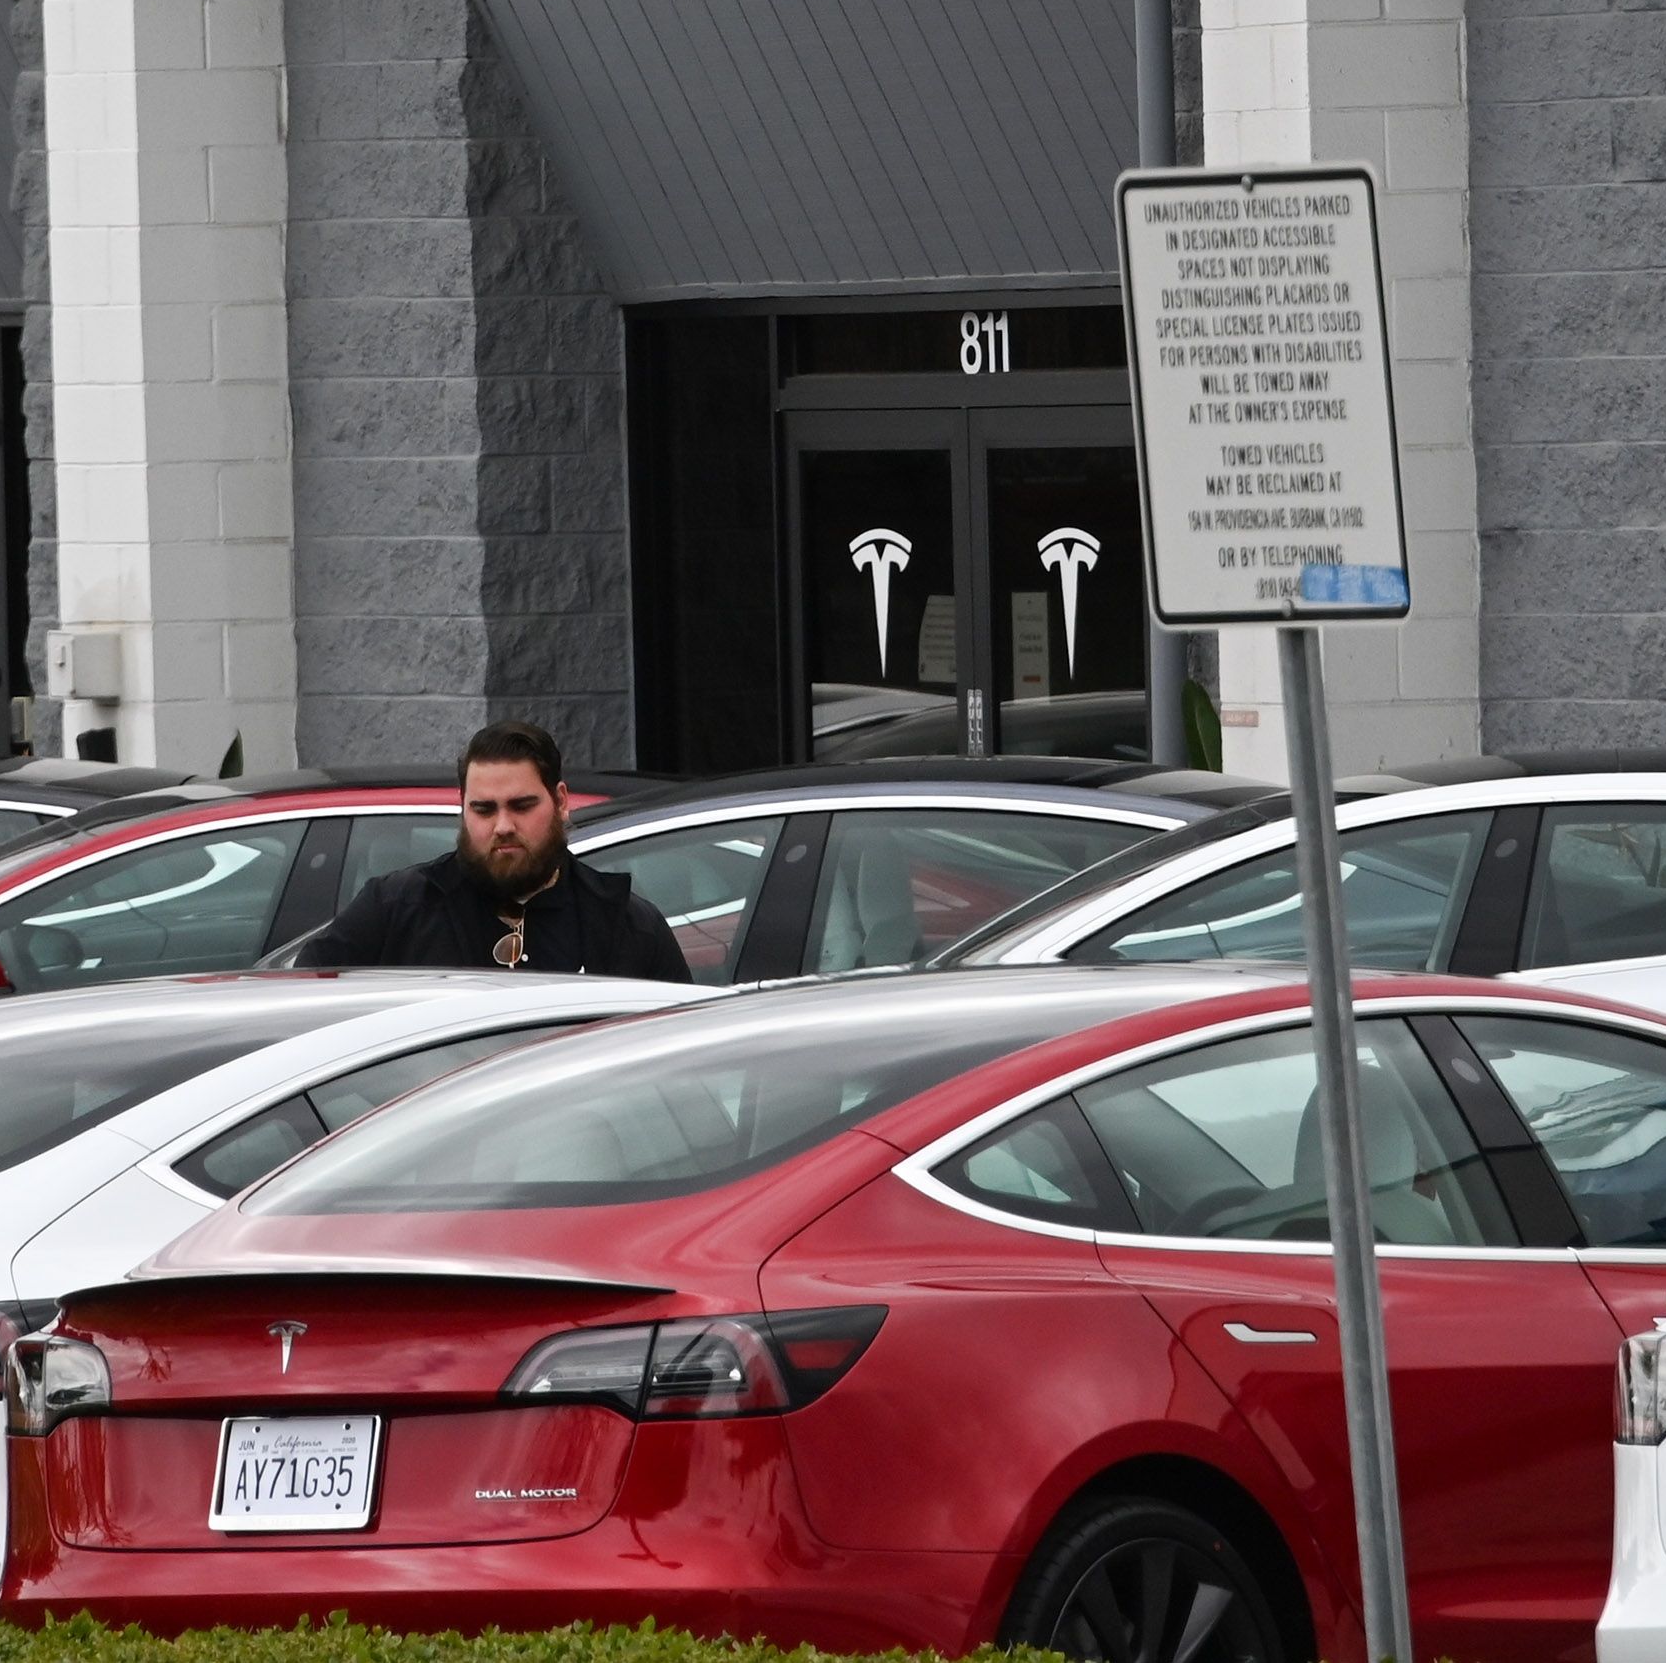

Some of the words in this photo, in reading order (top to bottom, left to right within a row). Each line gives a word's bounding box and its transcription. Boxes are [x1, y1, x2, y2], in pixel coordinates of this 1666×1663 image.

[1144, 200, 1239, 224] UNAUTHORIZED
[1243, 197, 1300, 220] VEHICLES
[1304, 195, 1350, 216] PARKED
[1165, 230, 1178, 252] IN
[1183, 228, 1258, 251] DESIGNATED
[1263, 224, 1336, 248] ACCESSIBLE
[1178, 257, 1225, 280] SPACES
[1230, 256, 1253, 278] NOT
[1258, 254, 1330, 277] DISPLAYING
[1161, 286, 1262, 310] DISTINGUISHING
[1266, 283, 1329, 306] PLACARDS
[1334, 282, 1350, 303] OR
[1155, 317, 1209, 339] SPECIAL
[1212, 314, 1264, 336] LICENSE
[1267, 312, 1314, 335] PLATES
[1318, 310, 1362, 333] ISSUED
[960, 310, 1010, 375] 811
[1160, 346, 1184, 368] FOR
[1189, 344, 1248, 367] PERSONS
[1251, 342, 1281, 365] WITH
[1284, 340, 1363, 364] DISABILITIES
[1200, 374, 1230, 396] WILL
[1234, 373, 1250, 394] BE
[1254, 371, 1295, 393] TOWED
[1298, 371, 1329, 392] AWAY
[1189, 403, 1203, 425] AT
[1207, 402, 1231, 424] THE
[1235, 400, 1289, 423] OWNER'S
[1292, 399, 1347, 421] EXPENSE
[1221, 444, 1262, 467] TOWED
[1266, 442, 1325, 465] VEHICLES
[1205, 474, 1231, 496] MAY
[1236, 474, 1253, 495] BE
[1257, 471, 1324, 494] RECLAIMED
[1328, 471, 1342, 493] AT
[1215, 508, 1269, 530] PROVIDENCIA
[1290, 506, 1329, 530] BURBANK,
[1330, 506, 1341, 528] CA
[1218, 546, 1235, 568] OR
[1240, 545, 1257, 567] BY
[1262, 543, 1343, 566] TELEPHONING
[274, 1435, 323, 1454] California
[235, 1455, 355, 1501] AY71G35
[475, 1490, 516, 1499] DUAL
[520, 1488, 577, 1498] MOTOR
